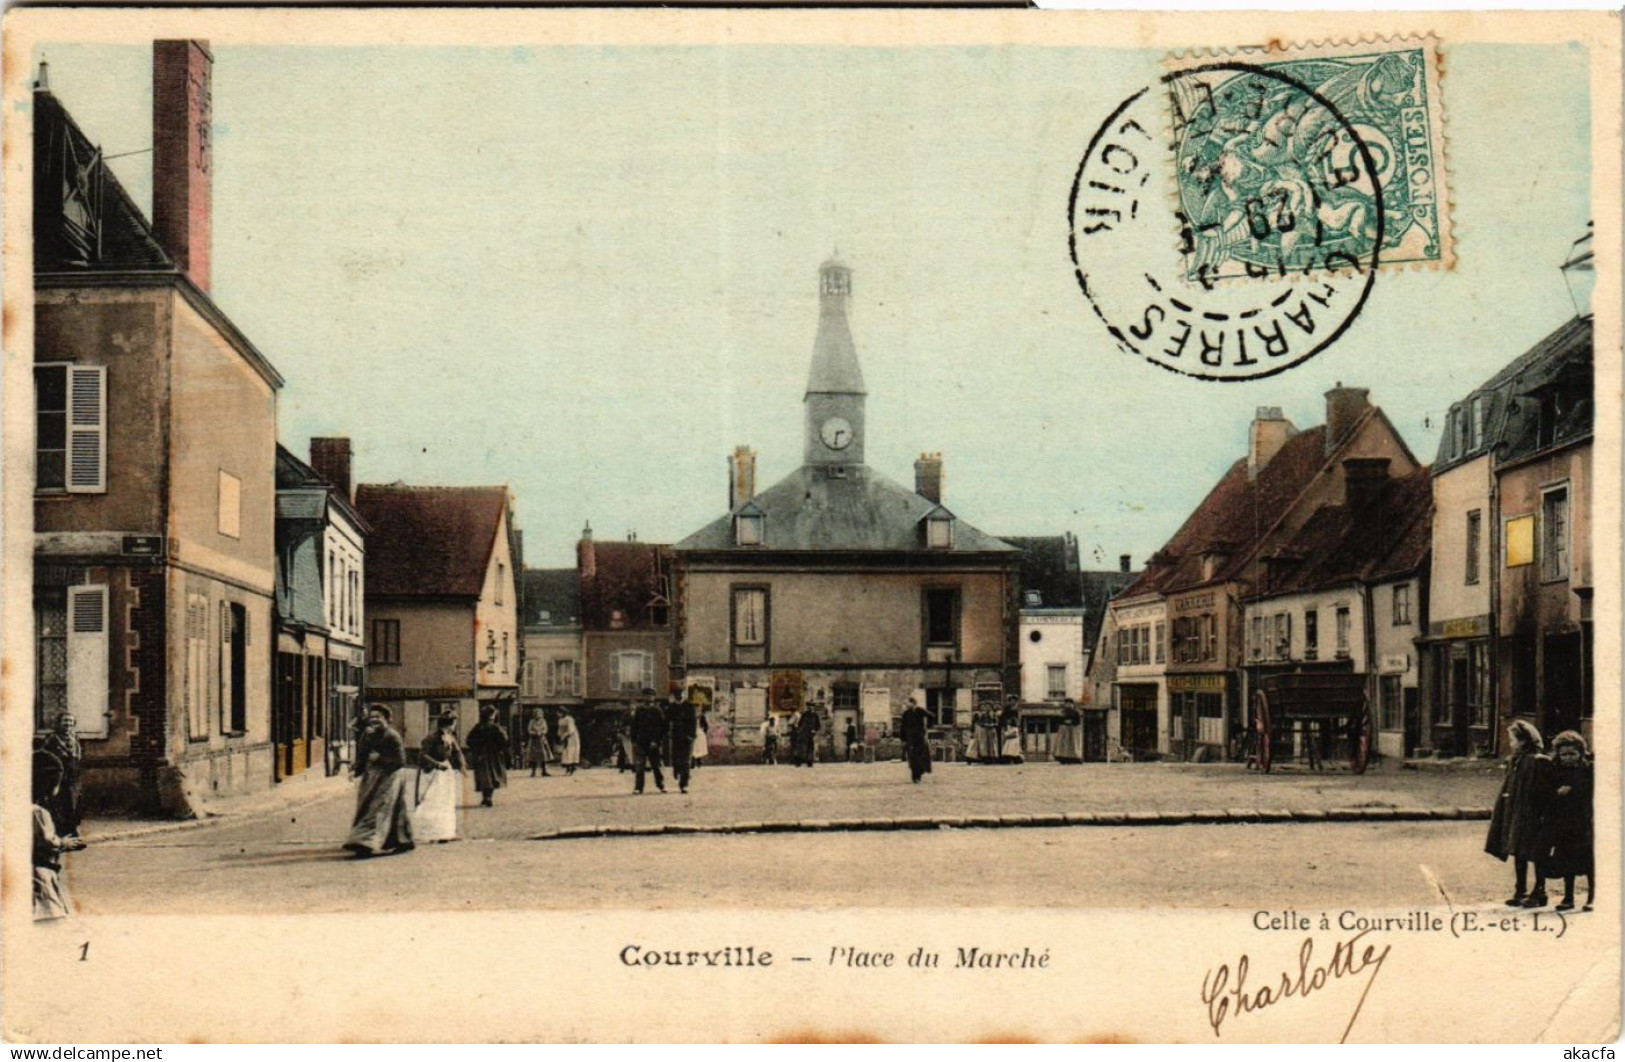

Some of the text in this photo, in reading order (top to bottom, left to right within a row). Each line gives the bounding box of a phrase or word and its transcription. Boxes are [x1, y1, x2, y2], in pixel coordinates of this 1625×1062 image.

[1404, 110, 1435, 203] POSTES
[1253, 910, 1311, 932] Celle
[1318, 911, 1331, 932] à
[1338, 910, 1443, 932] Courville
[78, 941, 90, 962] 1
[619, 944, 1051, 969] Courville Place du Marché
[1202, 928, 1392, 1044] Charlotte
